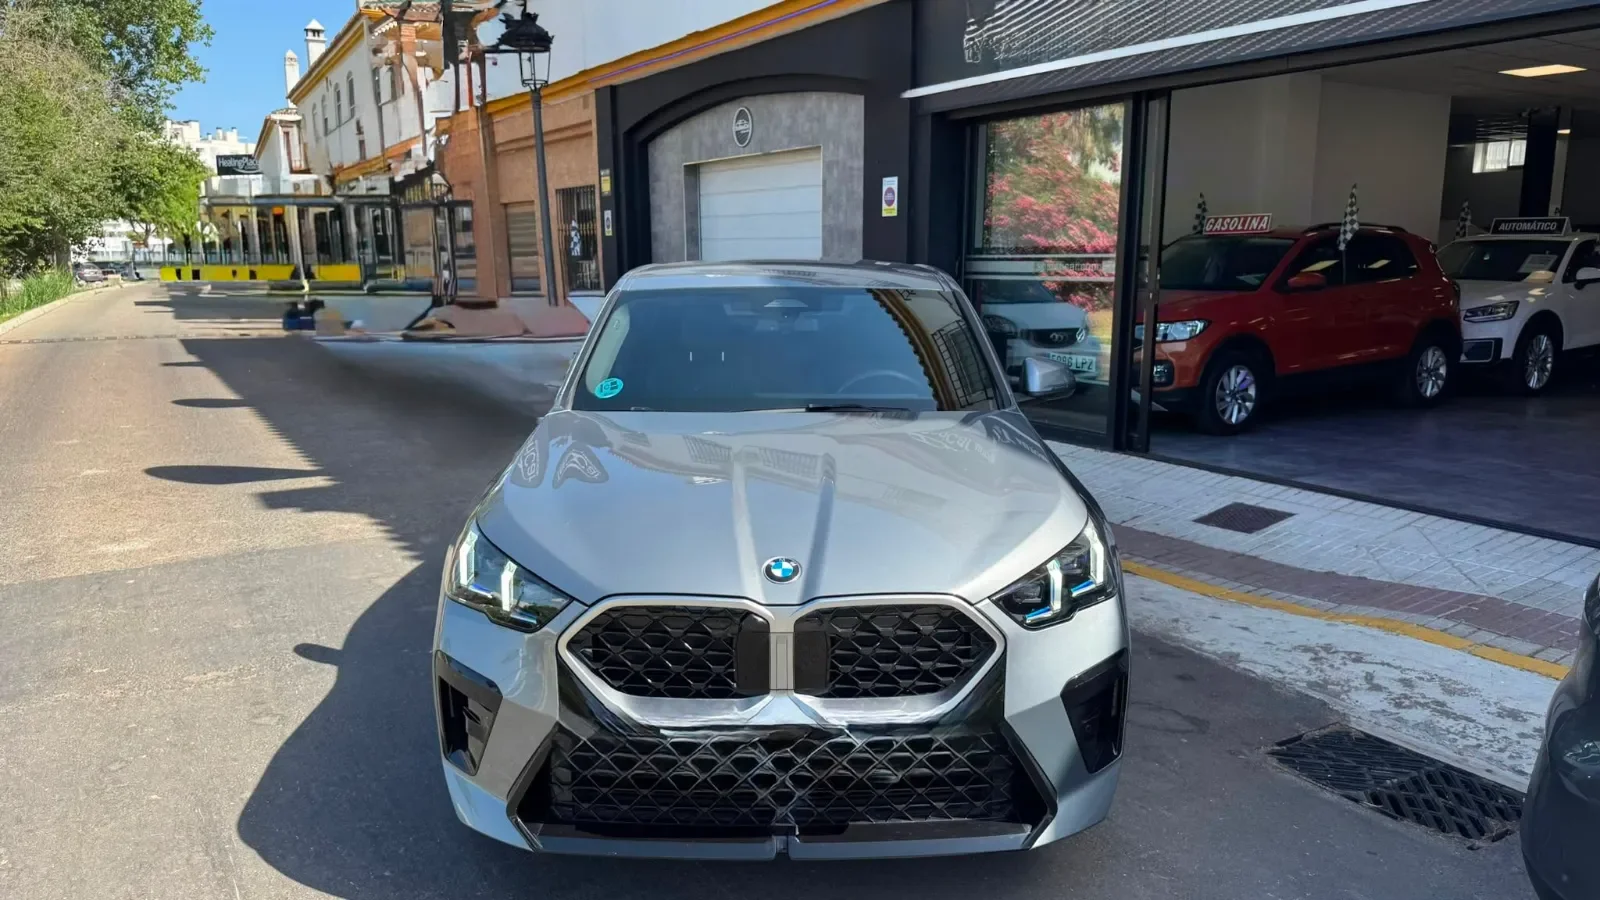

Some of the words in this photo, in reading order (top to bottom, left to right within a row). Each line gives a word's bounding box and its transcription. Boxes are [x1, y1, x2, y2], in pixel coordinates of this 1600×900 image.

[1205, 215, 1269, 232] GASOLINA
[1498, 220, 1557, 231] AUTOMÁTICO
[1075, 357, 1093, 370] LPZ
